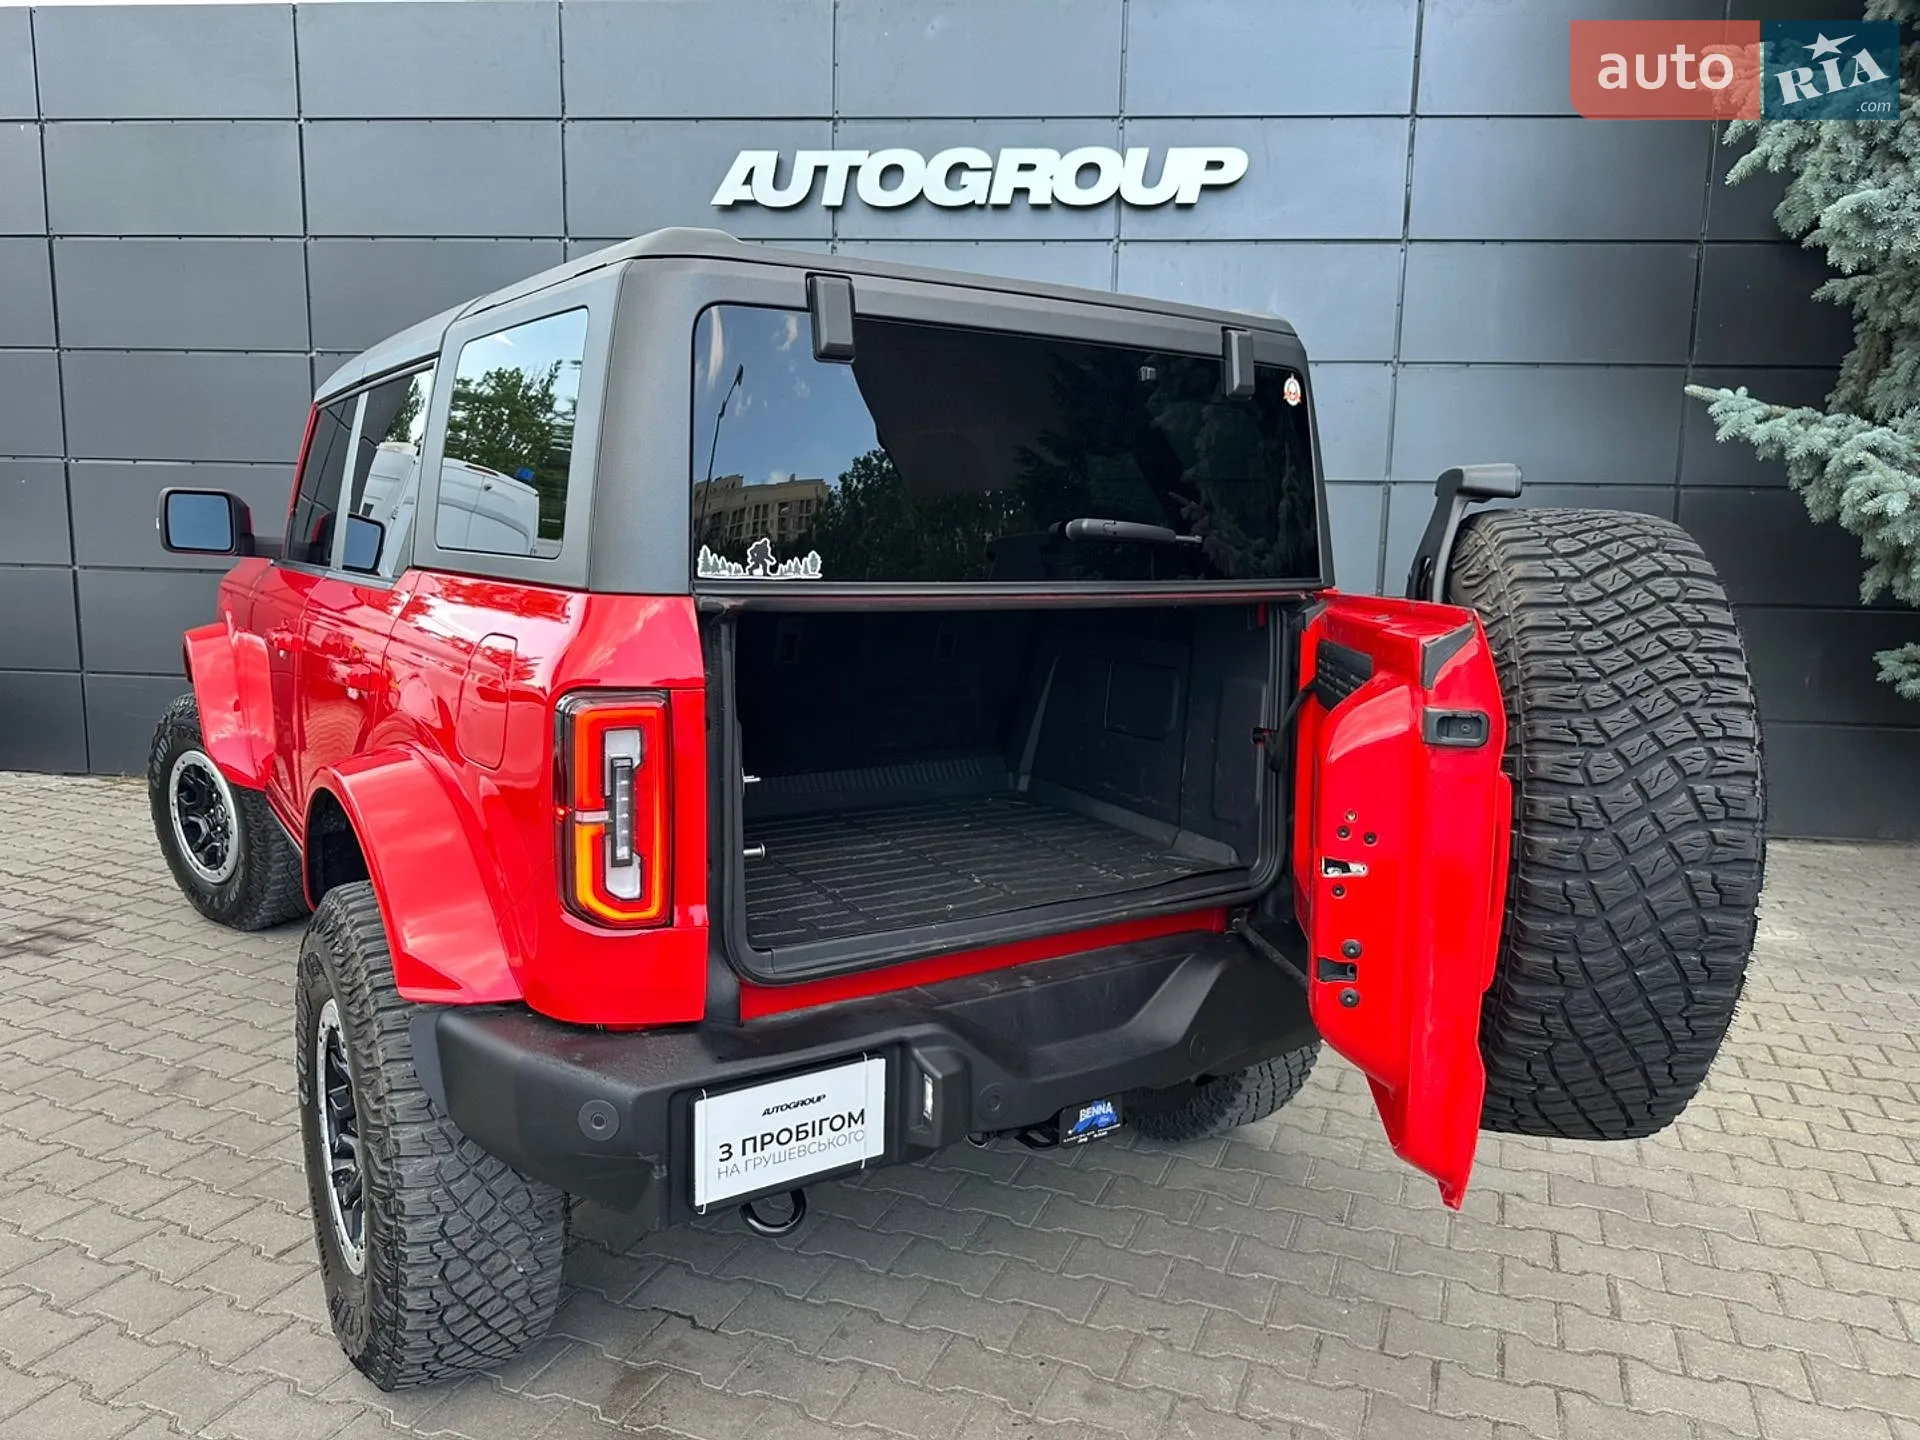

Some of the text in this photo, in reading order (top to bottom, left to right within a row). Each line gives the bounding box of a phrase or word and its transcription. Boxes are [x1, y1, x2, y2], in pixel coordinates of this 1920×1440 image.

[710, 146, 1249, 208] AUTOGROUP
[762, 1094, 826, 1116] AUTOGROUP
[1079, 1101, 1113, 1122] BENNA
[717, 1129, 865, 1179] НА ГРУШЕВСЬКОГО
[718, 1108, 865, 1162] З ПРОБІГОМ
